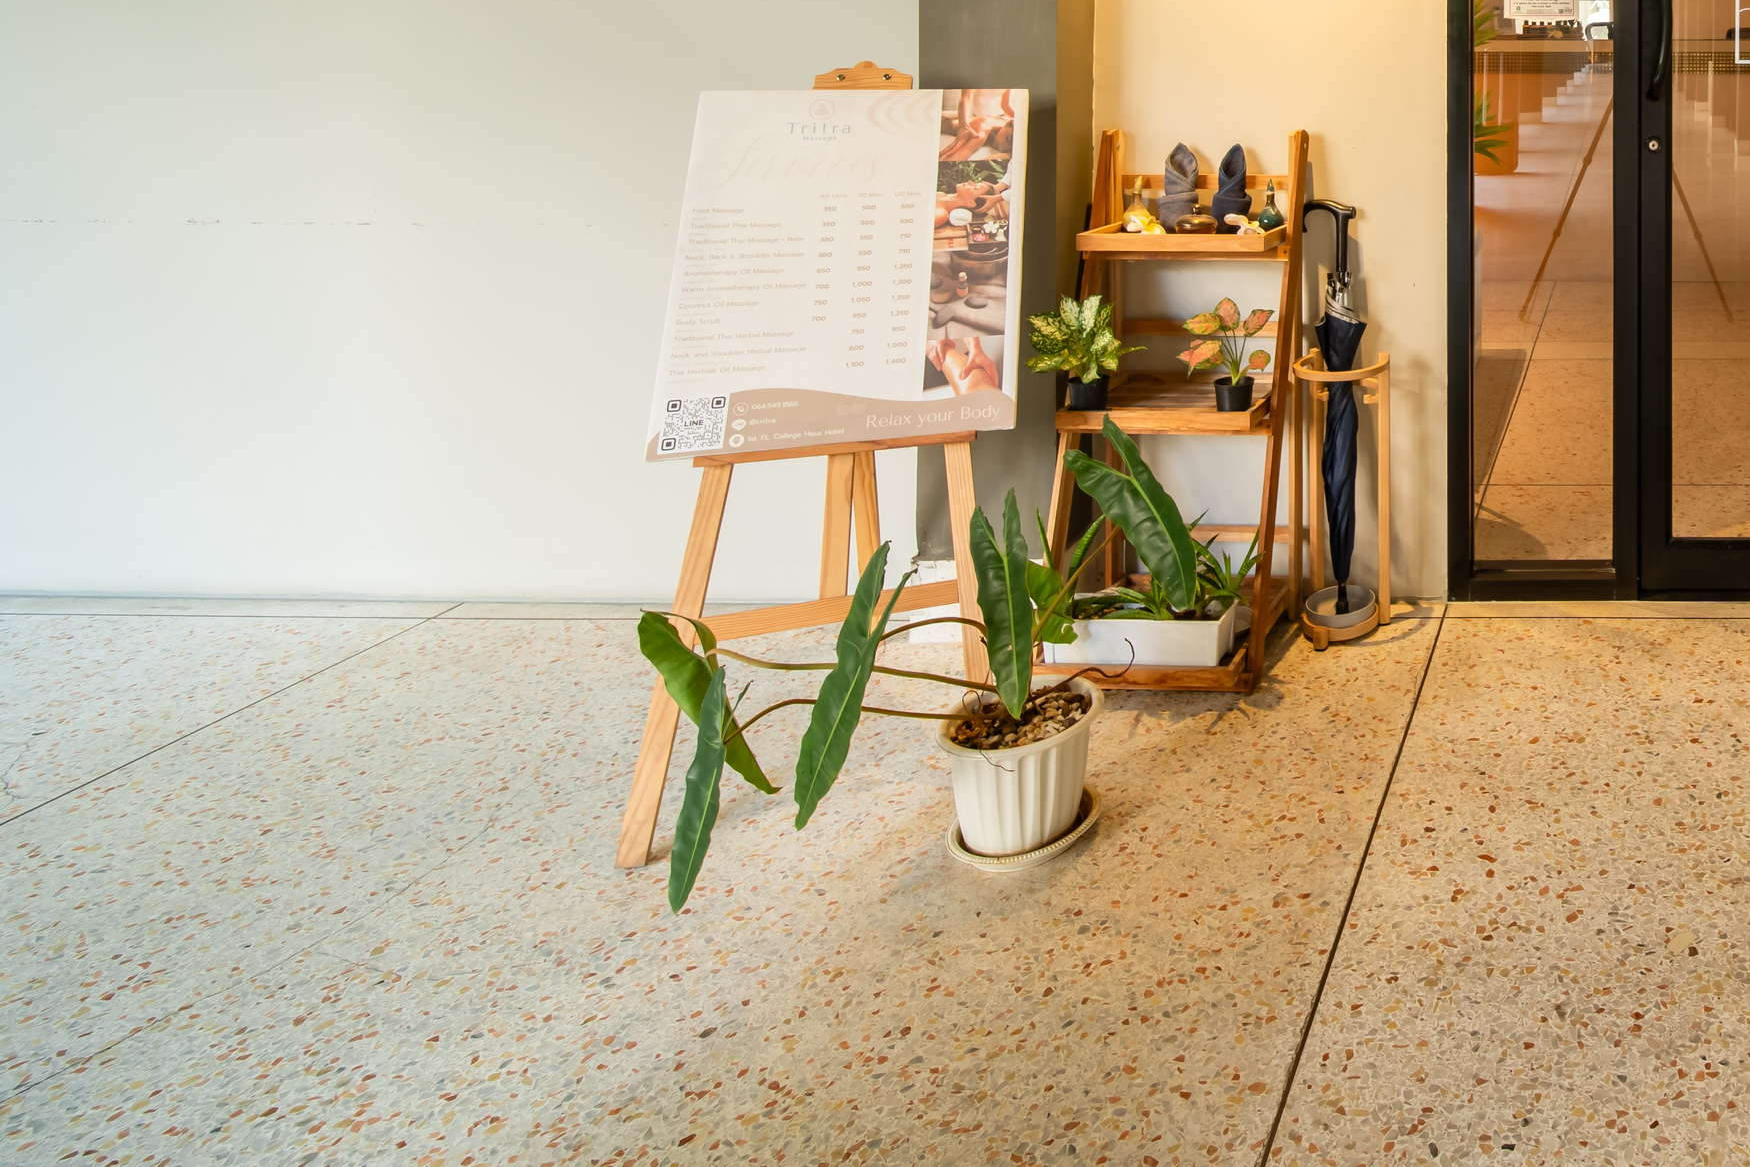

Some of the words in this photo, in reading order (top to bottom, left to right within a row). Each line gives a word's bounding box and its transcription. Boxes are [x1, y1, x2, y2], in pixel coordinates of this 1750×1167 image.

[787, 122, 851, 135] Tritra
[866, 413, 912, 429] Relax
[917, 410, 955, 428] your
[960, 404, 1001, 422] Body
[684, 419, 704, 428] LINE
[773, 432, 802, 440] College
[824, 428, 845, 436] Hotel
